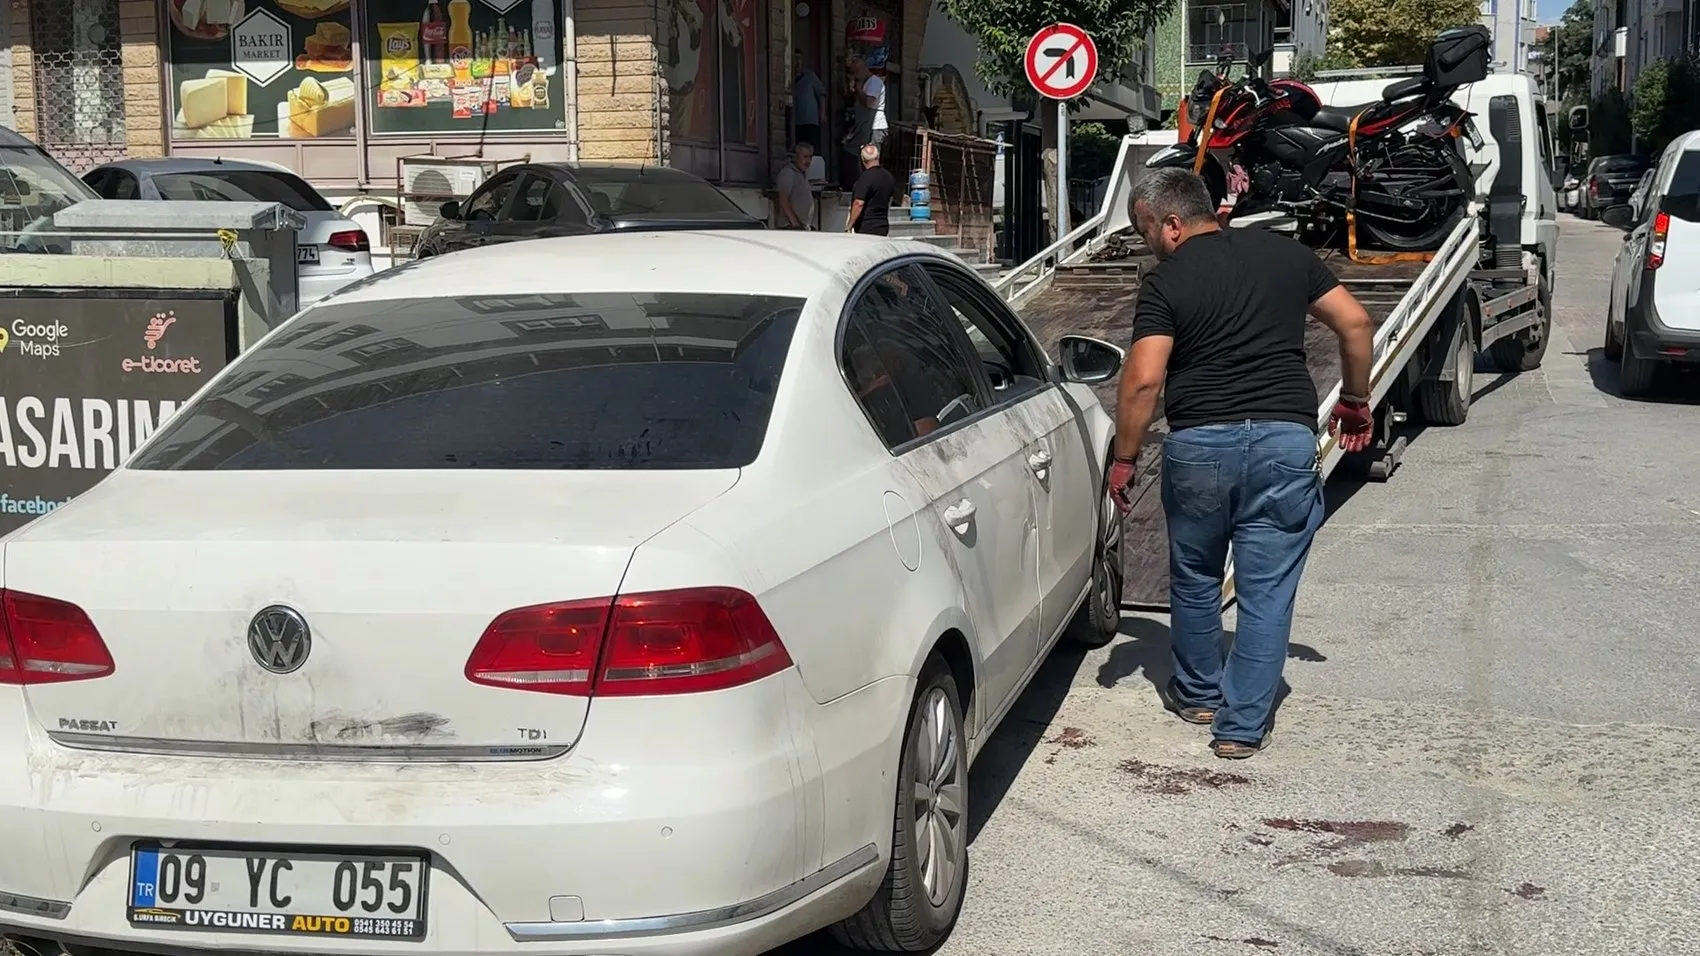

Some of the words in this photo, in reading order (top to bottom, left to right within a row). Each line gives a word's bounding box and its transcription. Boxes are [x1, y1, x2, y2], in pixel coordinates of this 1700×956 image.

[239, 34, 285, 47] BAKIR
[243, 49, 281, 59] MARKET
[12, 319, 69, 340] Google
[20, 340, 60, 359] Maps
[121, 355, 202, 374] e-ticaret
[1, 493, 71, 514] facebo
[59, 717, 118, 732] PASSAT
[517, 727, 547, 740] TDI
[137, 882, 154, 897] TR
[158, 854, 207, 904] 09
[246, 857, 293, 908] YC
[333, 860, 412, 913] 055
[185, 910, 286, 930] UYGUNER
[293, 916, 349, 933] AUTO
